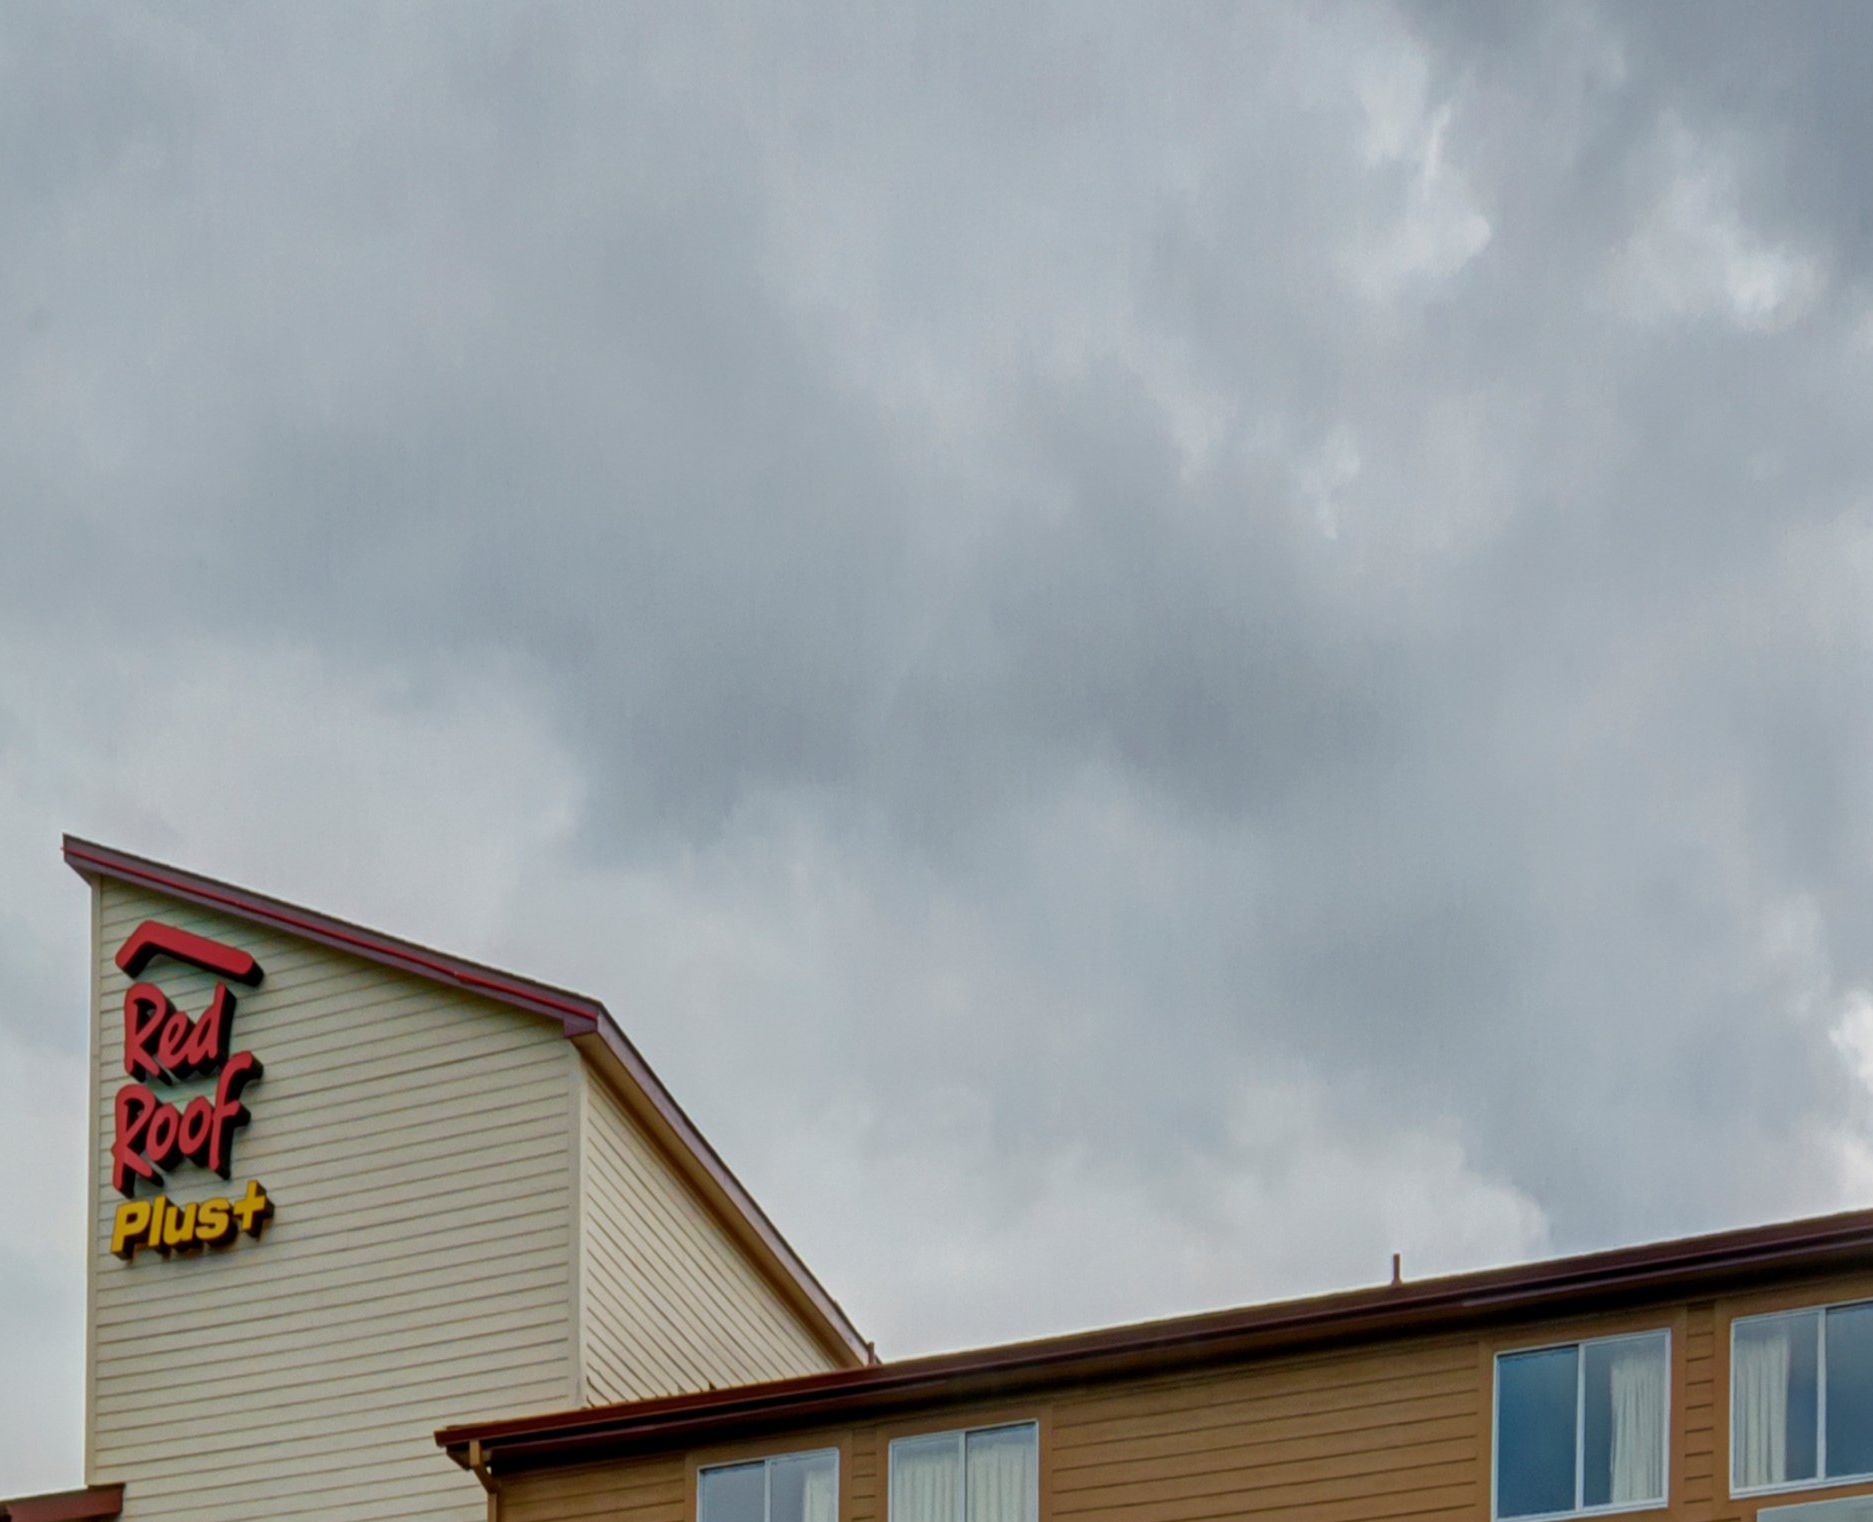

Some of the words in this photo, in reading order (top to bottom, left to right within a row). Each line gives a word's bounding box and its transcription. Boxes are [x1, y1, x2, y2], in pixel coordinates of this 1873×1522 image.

[123, 981, 230, 1079] Red
[111, 1050, 257, 1193] Roof
[110, 1179, 269, 1256] Plus+
